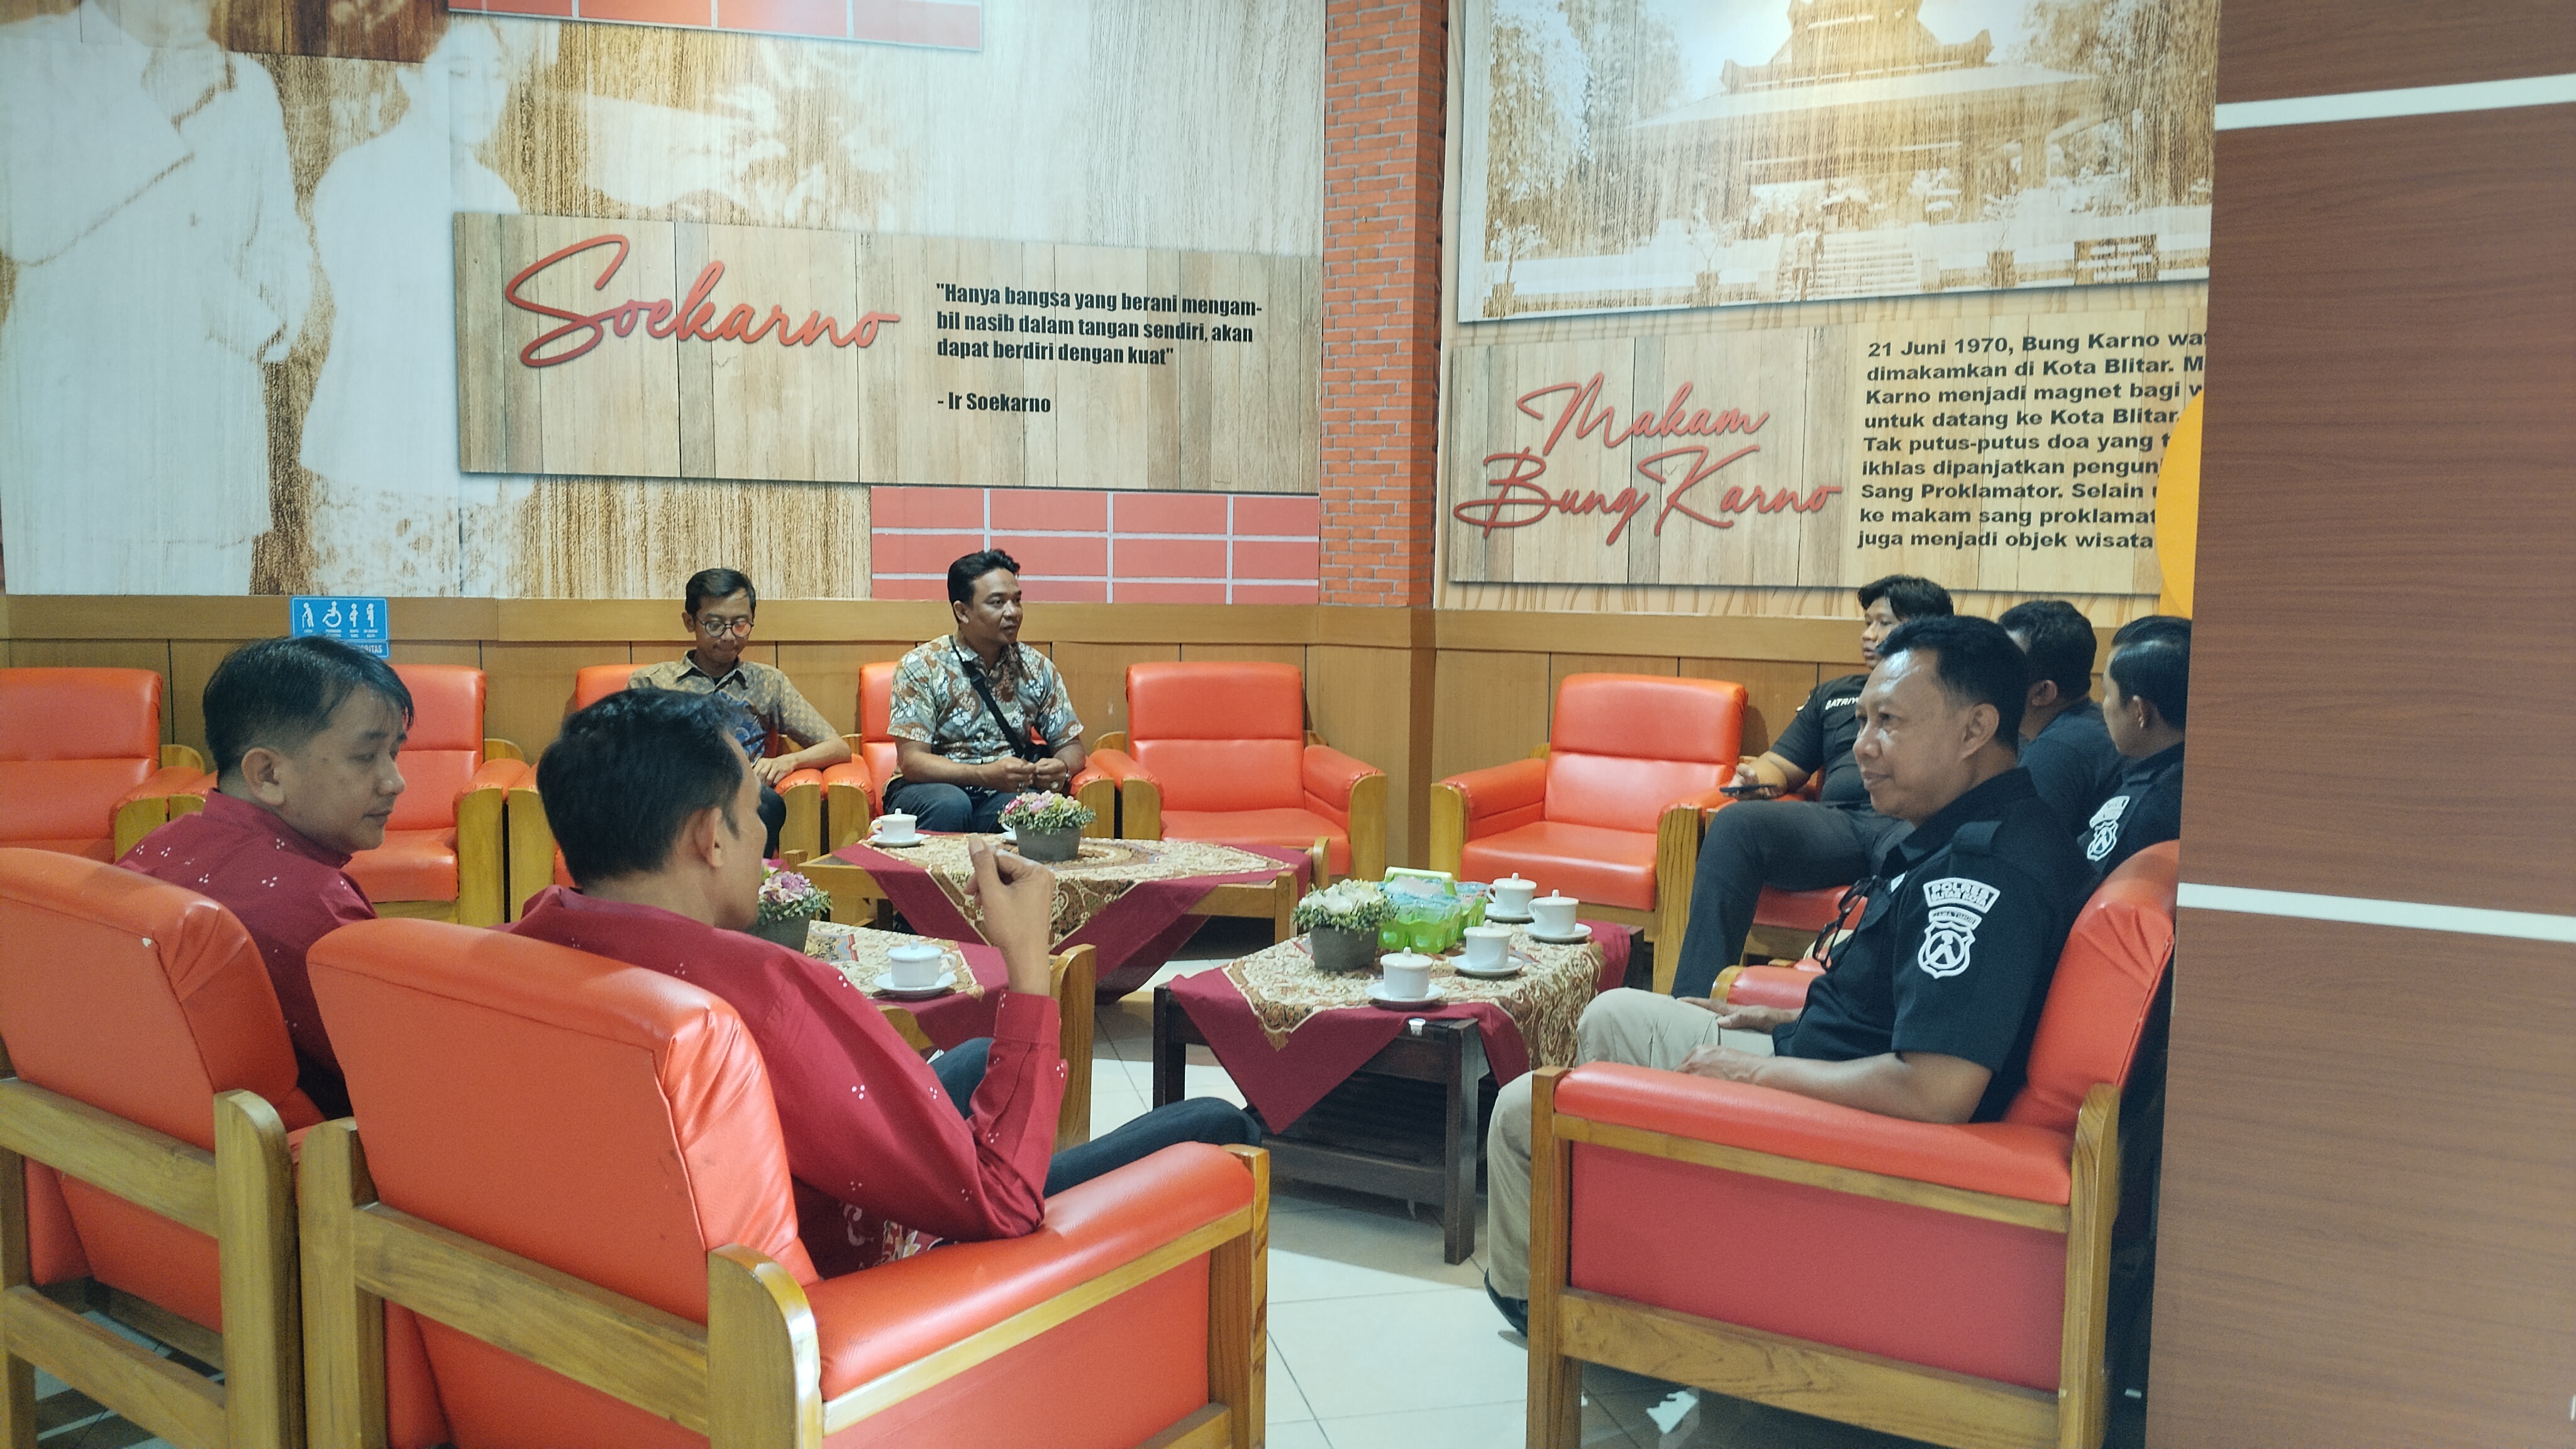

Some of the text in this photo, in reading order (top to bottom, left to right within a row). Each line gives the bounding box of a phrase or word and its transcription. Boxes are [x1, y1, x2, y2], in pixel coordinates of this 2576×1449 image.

[506, 234, 900, 367] Soekarno
[936, 283, 1263, 316] "Hanya bangsa yang berani mengam-
[936, 311, 1253, 343] bil nasib dalam tangan sendiri, akan
[936, 338, 1174, 365] dapat berdiri dengan kuat"
[1868, 342, 1892, 357] 21
[1901, 340, 1946, 355] Juni
[1954, 338, 2014, 355] 1970,
[2022, 336, 2079, 354] Bung
[2088, 334, 2160, 348] Karno
[1867, 364, 2007, 381] dimakamkan
[2014, 361, 2035, 376] di
[2043, 360, 2096, 375] Kota
[2105, 358, 2175, 374] Blitar.
[948, 392, 962, 410] Ir
[966, 393, 1051, 413] Soekarno
[1866, 390, 1930, 404] Karno
[1938, 386, 2027, 405] menjadi
[2033, 384, 2121, 403] magnet
[2130, 382, 2180, 401] bagi
[1517, 372, 1770, 455] Makam
[1864, 413, 1925, 428] untuk
[1932, 413, 2008, 429] datang
[2016, 411, 2043, 425] ke
[2050, 410, 2104, 425] Kota
[1863, 437, 1902, 452] Tak
[1909, 436, 2040, 454] putus-putus
[2047, 434, 2089, 449] doa
[2097, 436, 2153, 452] yang
[1862, 458, 2163, 479] ikhlas dipanjatkan pengun
[1453, 445, 1843, 546] Bung Karno
[1861, 484, 1913, 502] Sang
[1921, 484, 2064, 498] Proklamator.
[2072, 484, 2145, 498] Selain
[1859, 508, 1884, 522] ke
[1892, 508, 1972, 523] makam
[1979, 511, 2031, 526] sang
[1857, 531, 2153, 551] juga menjadi objek wisata
